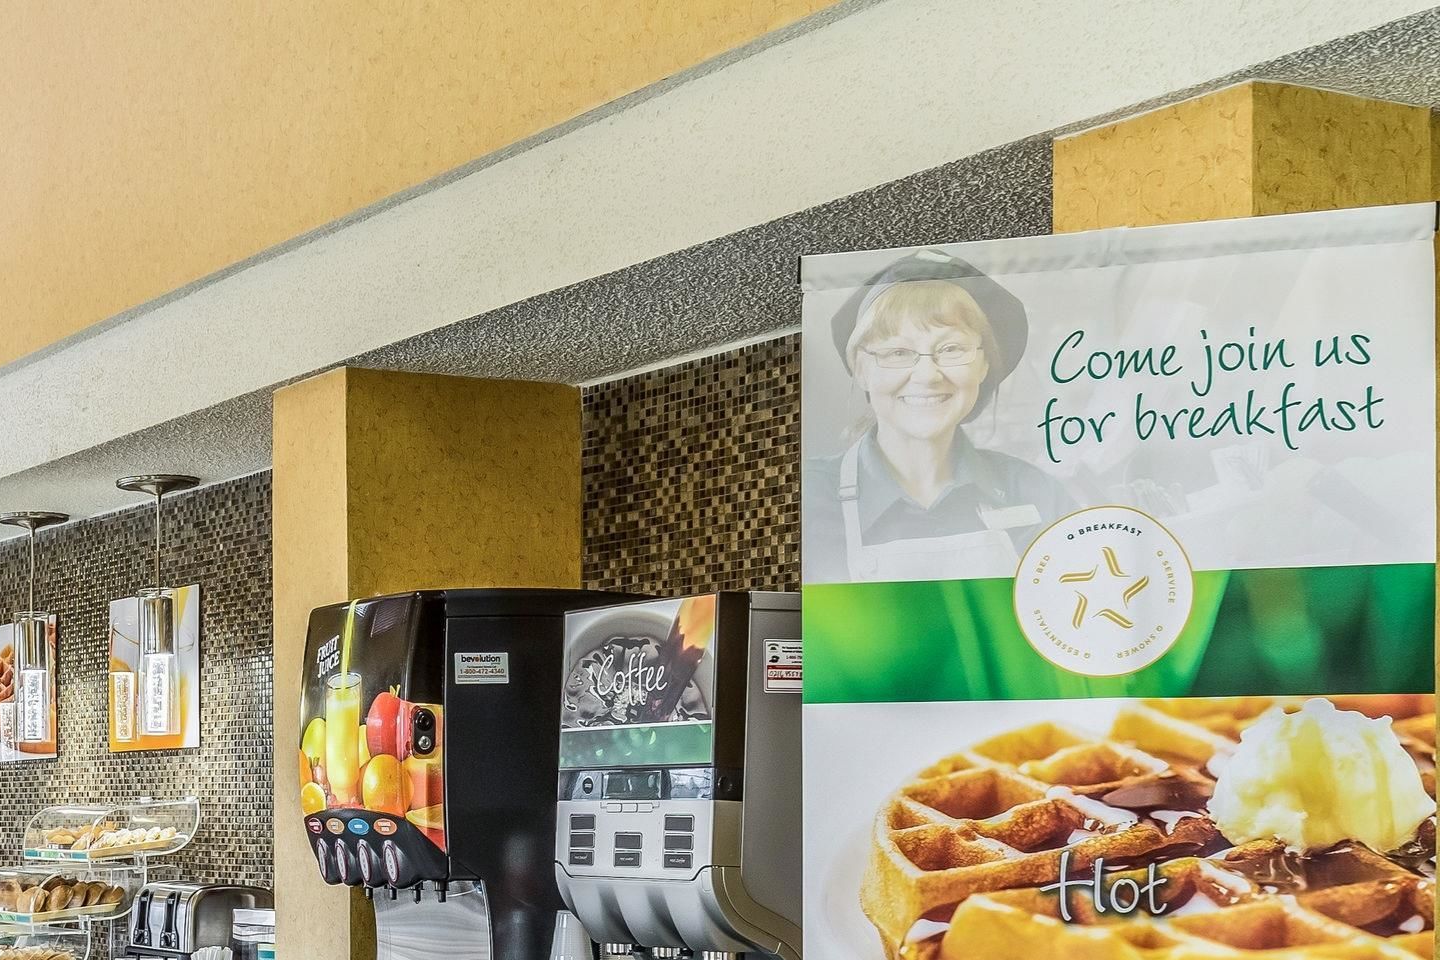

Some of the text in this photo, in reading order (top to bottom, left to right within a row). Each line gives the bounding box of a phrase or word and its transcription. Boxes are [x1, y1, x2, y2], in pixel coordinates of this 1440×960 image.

[1050, 326, 1371, 397] Come join us
[1036, 382, 1385, 464] for breakfast
[1066, 522, 1143, 541] Q BREAKFAST
[1033, 554, 1051, 585] Q BED
[1162, 560, 1176, 604] SERVICE
[316, 634, 340, 664] FRUIT
[1033, 609, 1080, 657] ESSENTIALS
[1116, 633, 1158, 659] SHOWER
[317, 650, 340, 679] JUICE
[461, 655, 501, 663] bevolution
[596, 651, 668, 706] Coffee
[1038, 850, 1168, 922] Hot
